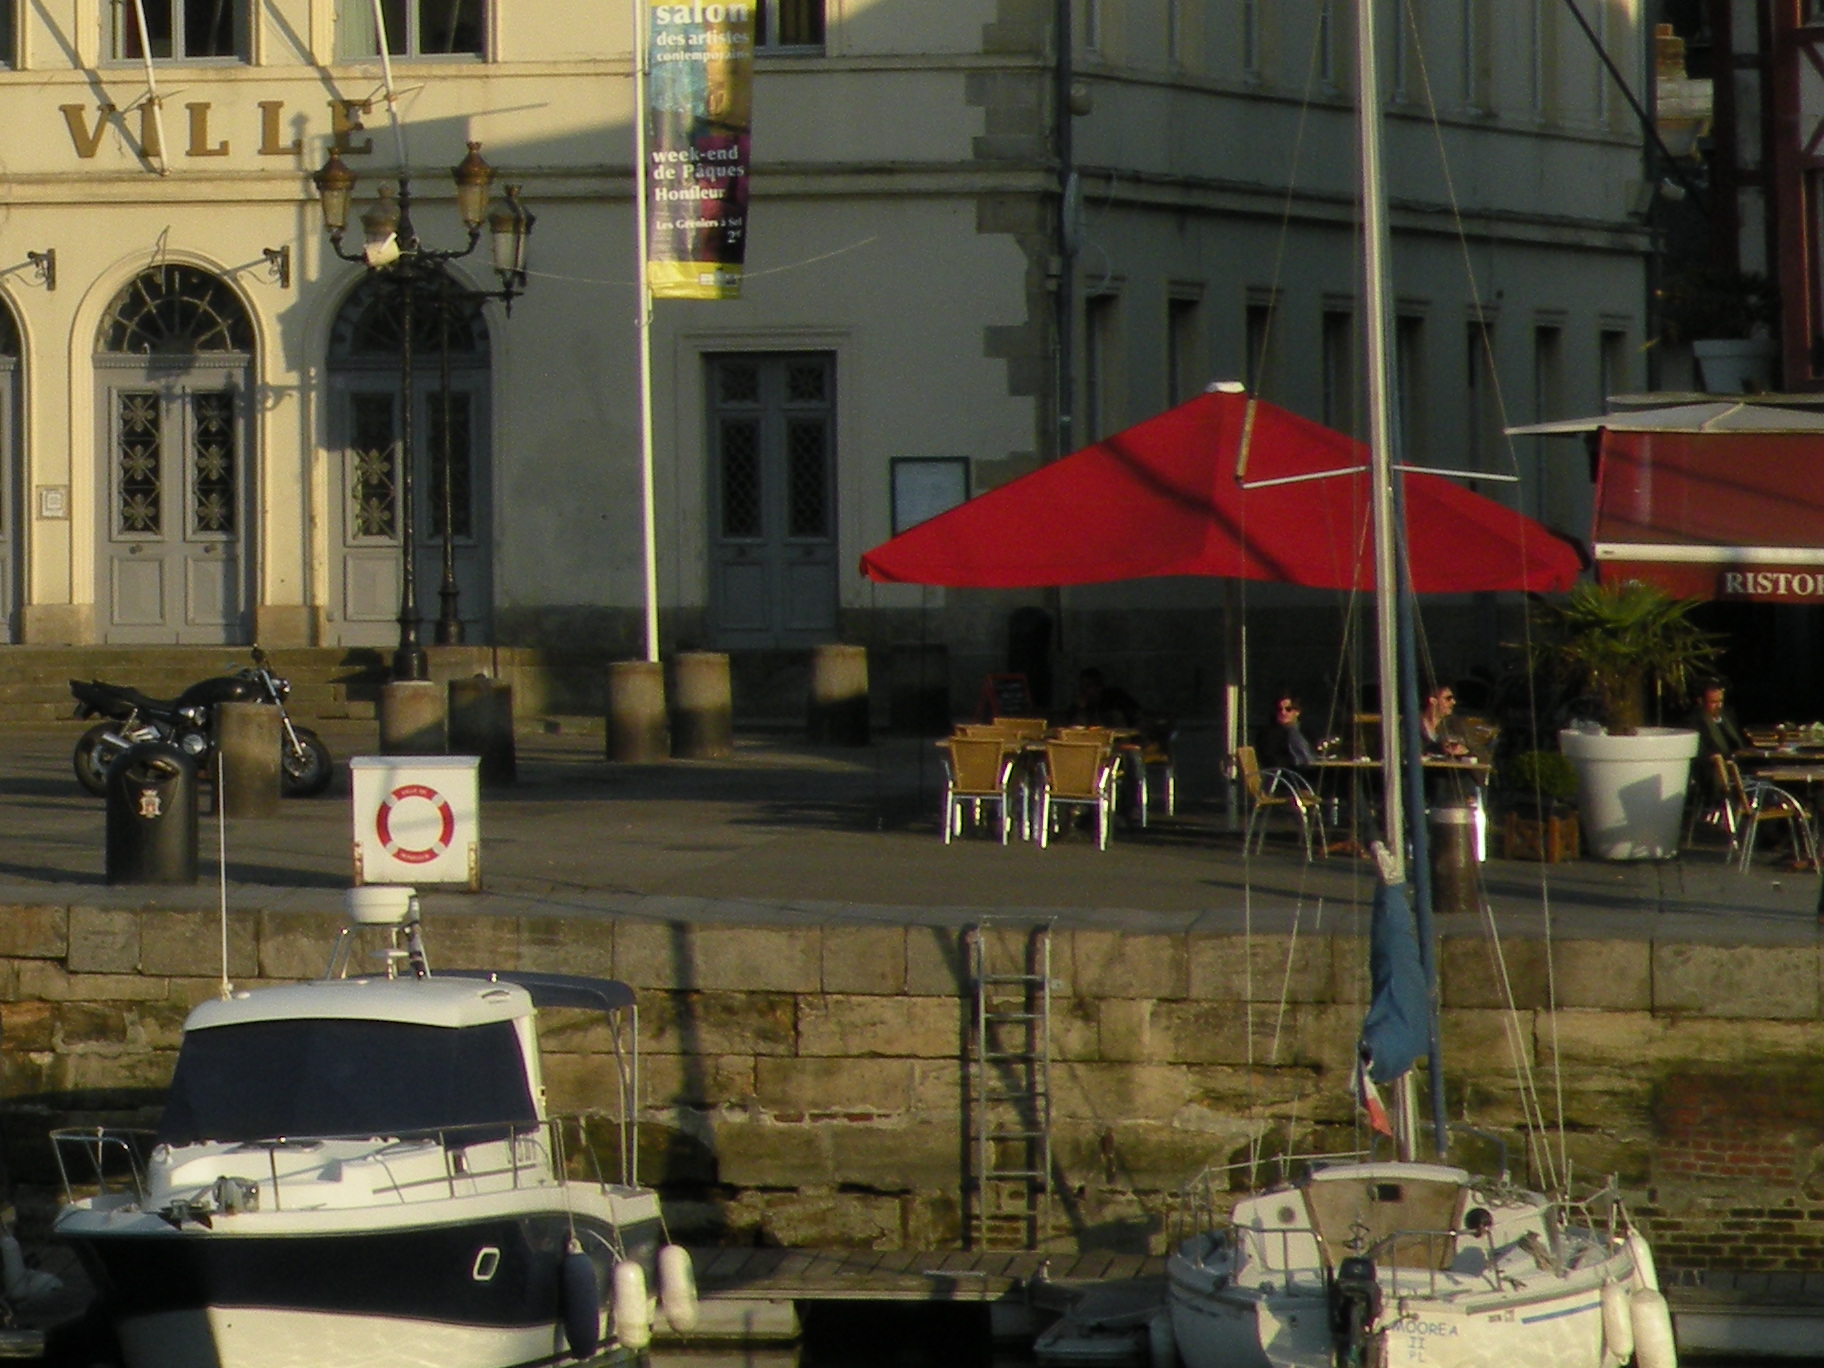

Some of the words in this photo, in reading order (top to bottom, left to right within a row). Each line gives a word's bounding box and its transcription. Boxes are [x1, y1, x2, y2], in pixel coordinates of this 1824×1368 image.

[656, 31, 685, 46] des
[688, 29, 750, 45] artistes
[59, 99, 373, 158] VILLE
[653, 146, 738, 163] week-end
[654, 165, 676, 180] de
[682, 164, 745, 182] Pâques
[655, 186, 725, 201] Honfleur
